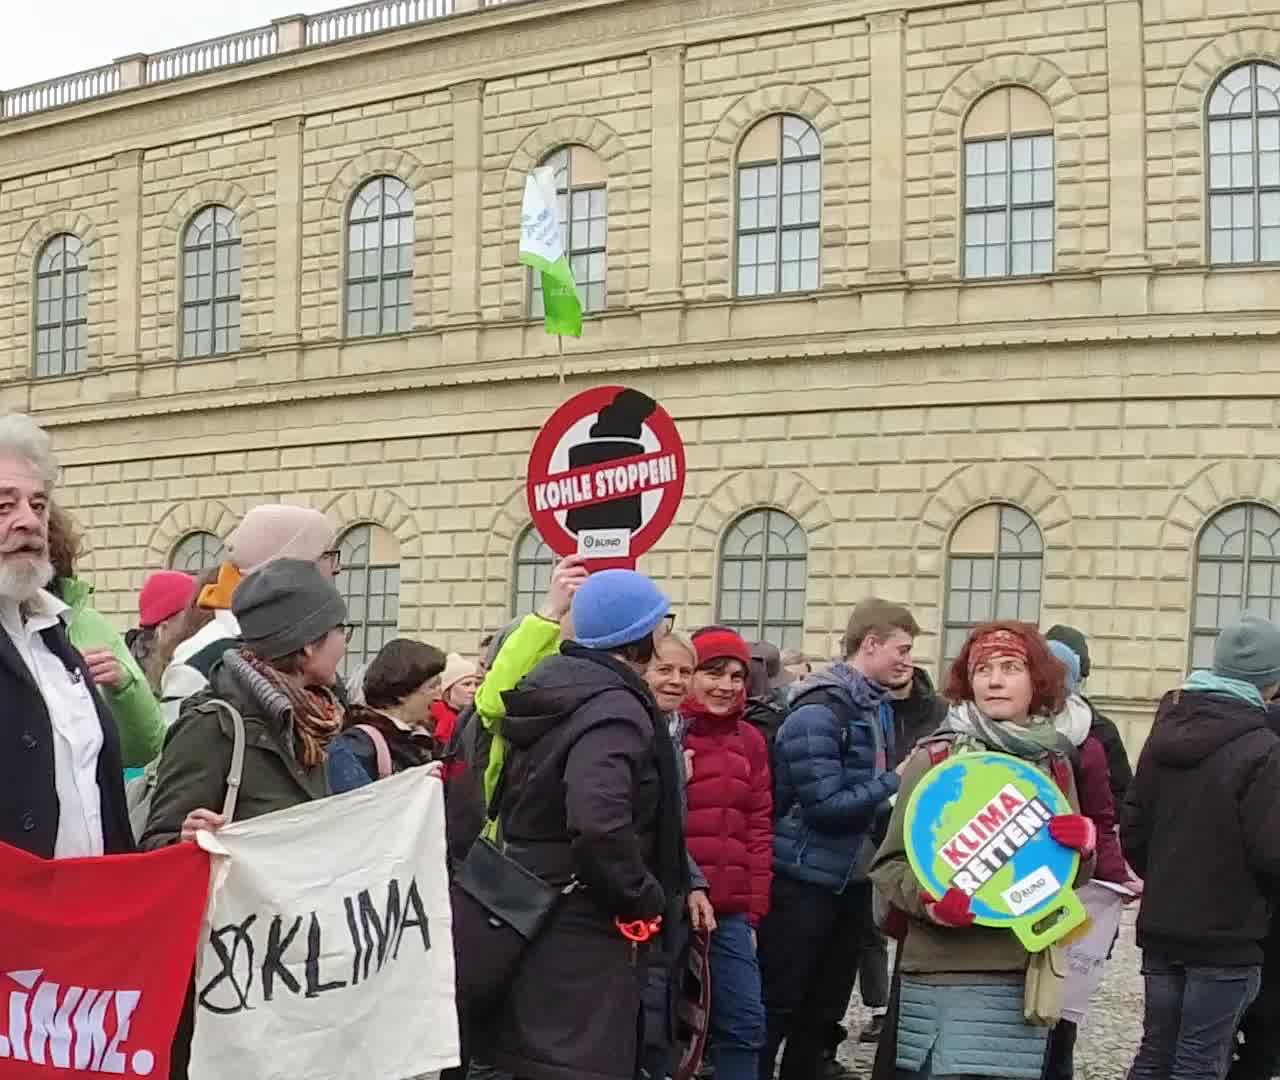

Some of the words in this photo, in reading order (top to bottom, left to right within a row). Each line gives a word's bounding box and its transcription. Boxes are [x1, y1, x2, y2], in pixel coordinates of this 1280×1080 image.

[534, 473, 593, 512] KOHLE
[595, 453, 678, 498] STOPPEN!
[942, 791, 1025, 867] KLIMA
[952, 799, 1053, 896] RETTEN!
